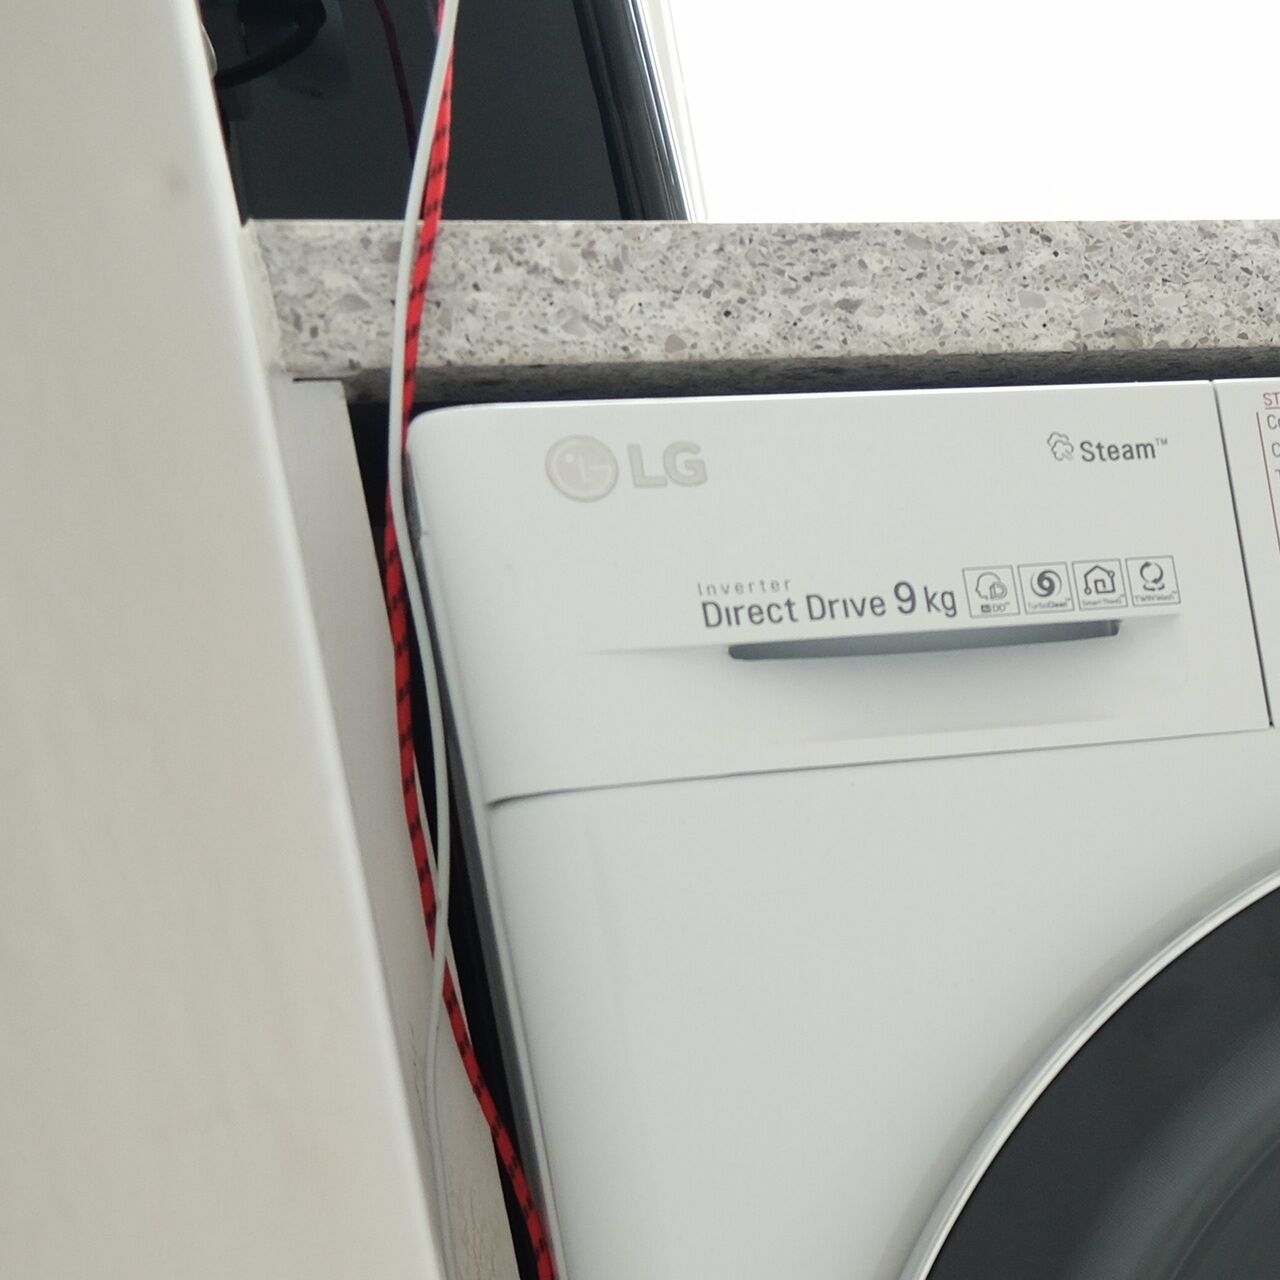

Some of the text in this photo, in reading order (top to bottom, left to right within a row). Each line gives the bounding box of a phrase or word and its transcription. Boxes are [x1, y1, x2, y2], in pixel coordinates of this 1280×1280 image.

[626, 440, 708, 489] LG
[697, 578, 792, 596] Inverter
[702, 594, 886, 628] Direct Drive
